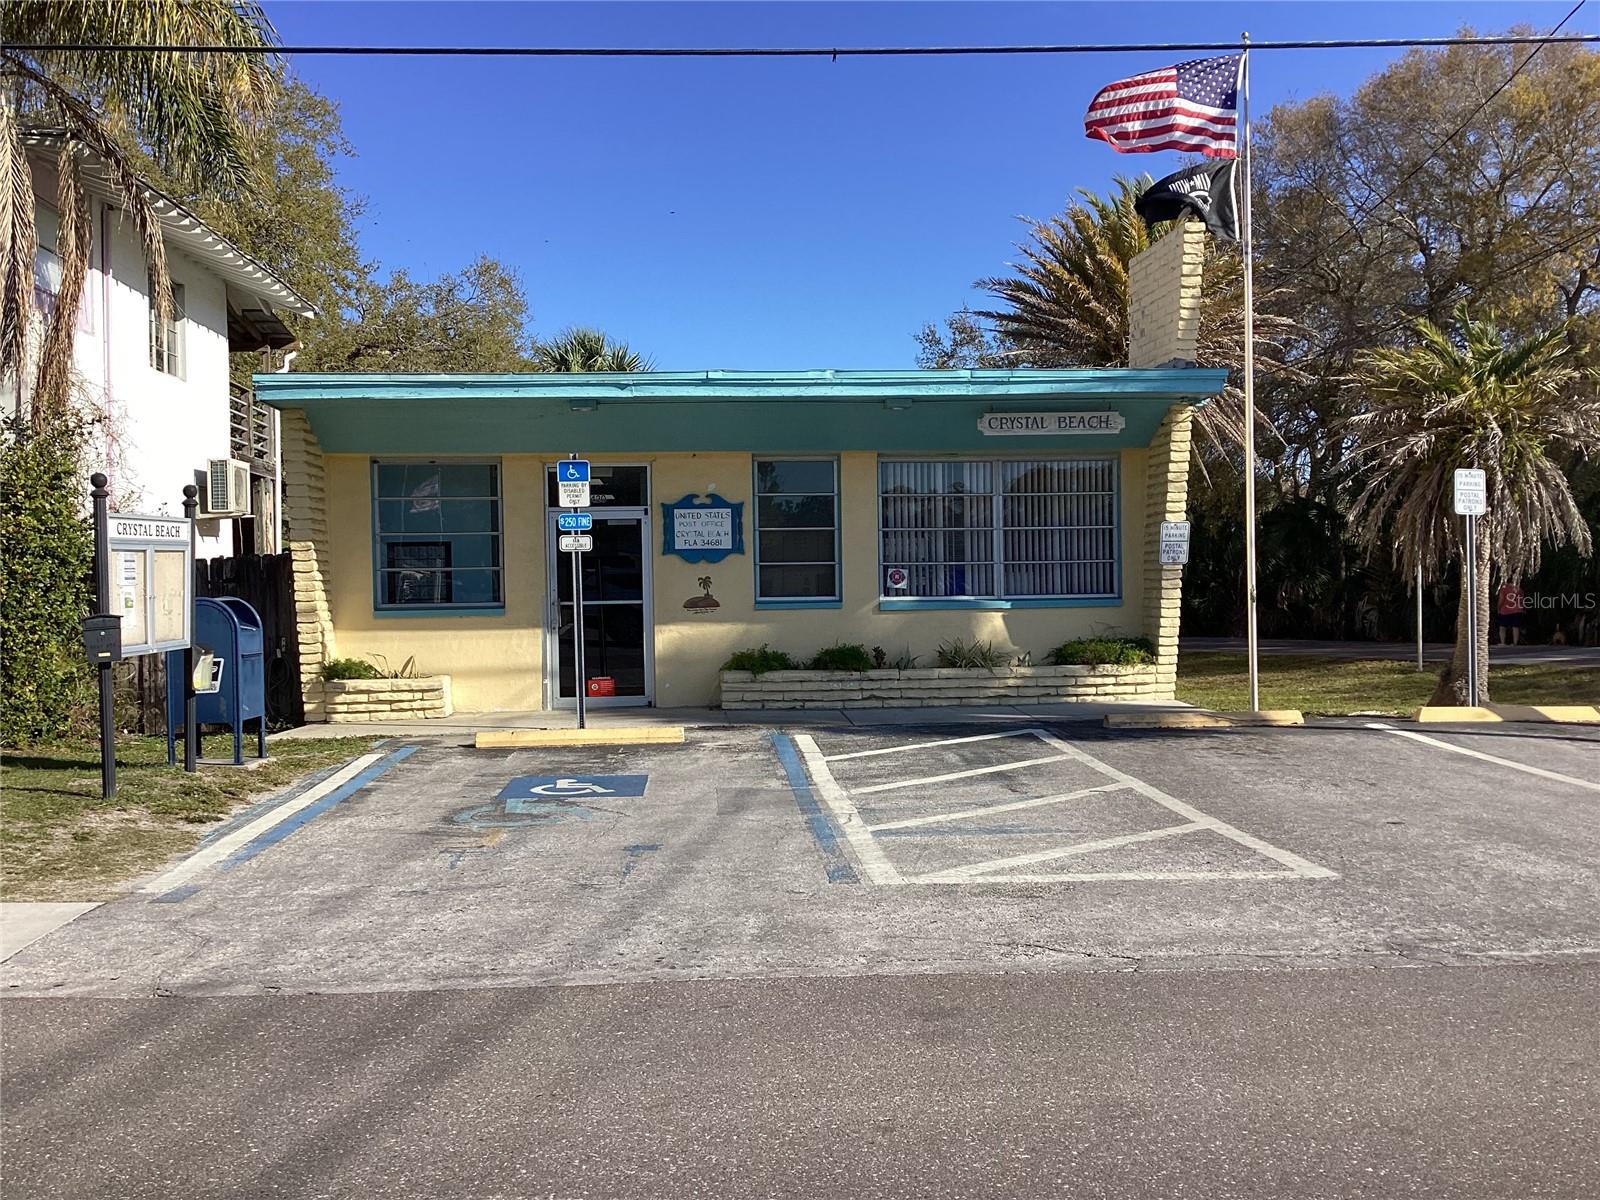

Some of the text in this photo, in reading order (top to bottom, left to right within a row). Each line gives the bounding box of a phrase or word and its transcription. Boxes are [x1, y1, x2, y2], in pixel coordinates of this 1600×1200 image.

[987, 415, 1110, 430] CRYSTAL BEACH
[675, 511, 731, 520] UNITED STATES
[560, 516, 590, 527] $250 FINE
[116, 523, 180, 537] CRYSTAL BEACH
[675, 530, 704, 538] CRYTAL
